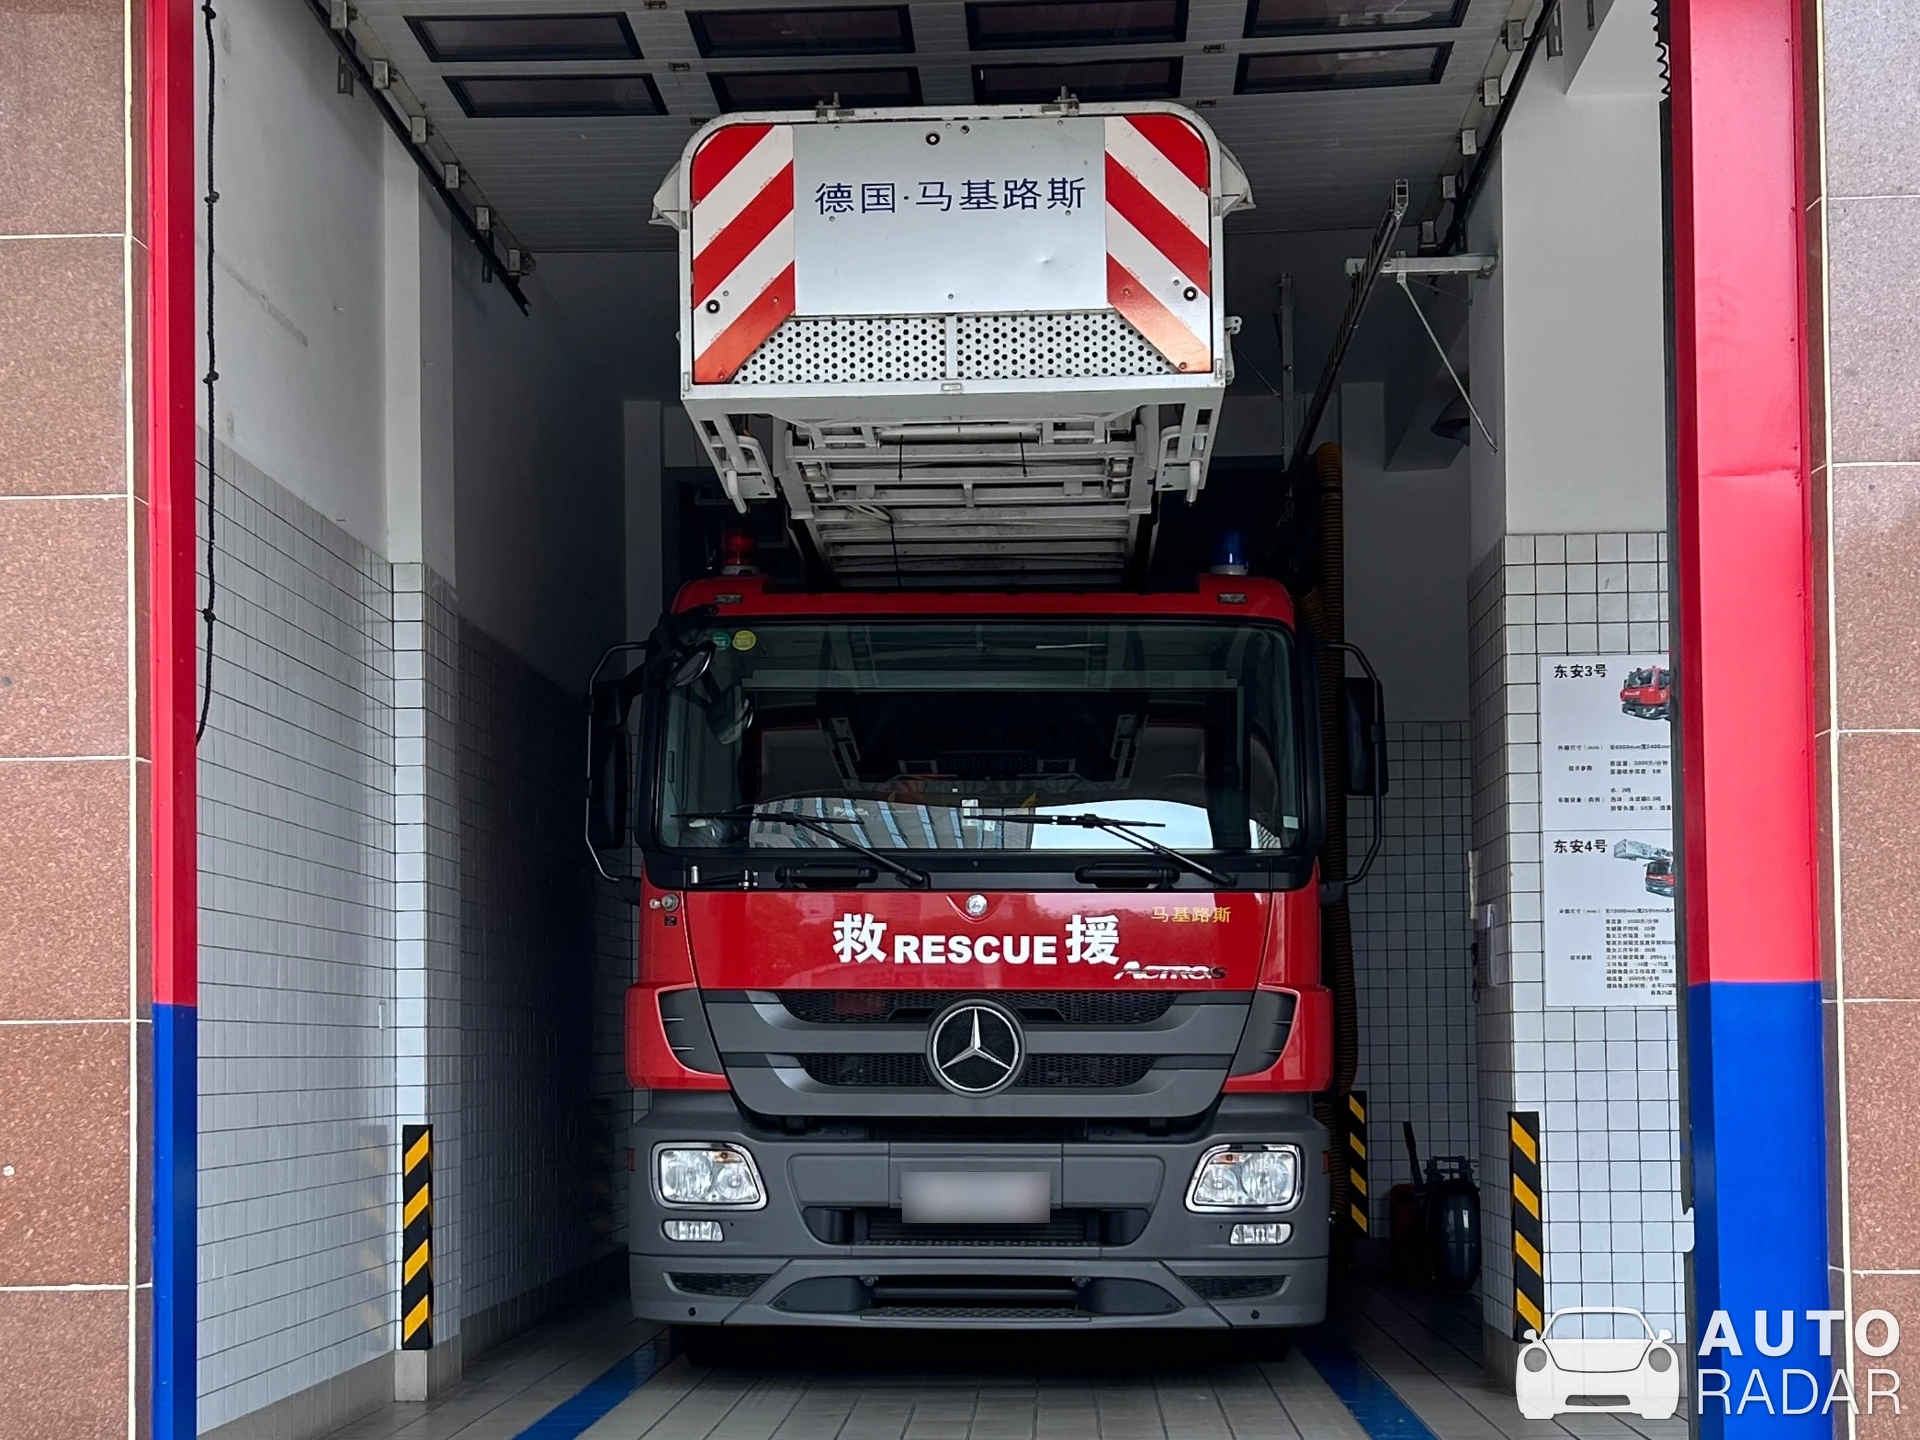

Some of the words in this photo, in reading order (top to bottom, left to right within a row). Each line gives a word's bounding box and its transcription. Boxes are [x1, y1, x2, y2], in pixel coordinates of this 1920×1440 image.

[815, 177, 1086, 215] 德国·马基路斯
[1553, 663, 1608, 678] 东安3号
[1553, 839, 1608, 853] 东安4号
[1151, 906, 1231, 923] 马基路斯
[832, 912, 887, 964] 救
[894, 935, 1057, 965] RESCUE
[1065, 914, 1120, 966] 援
